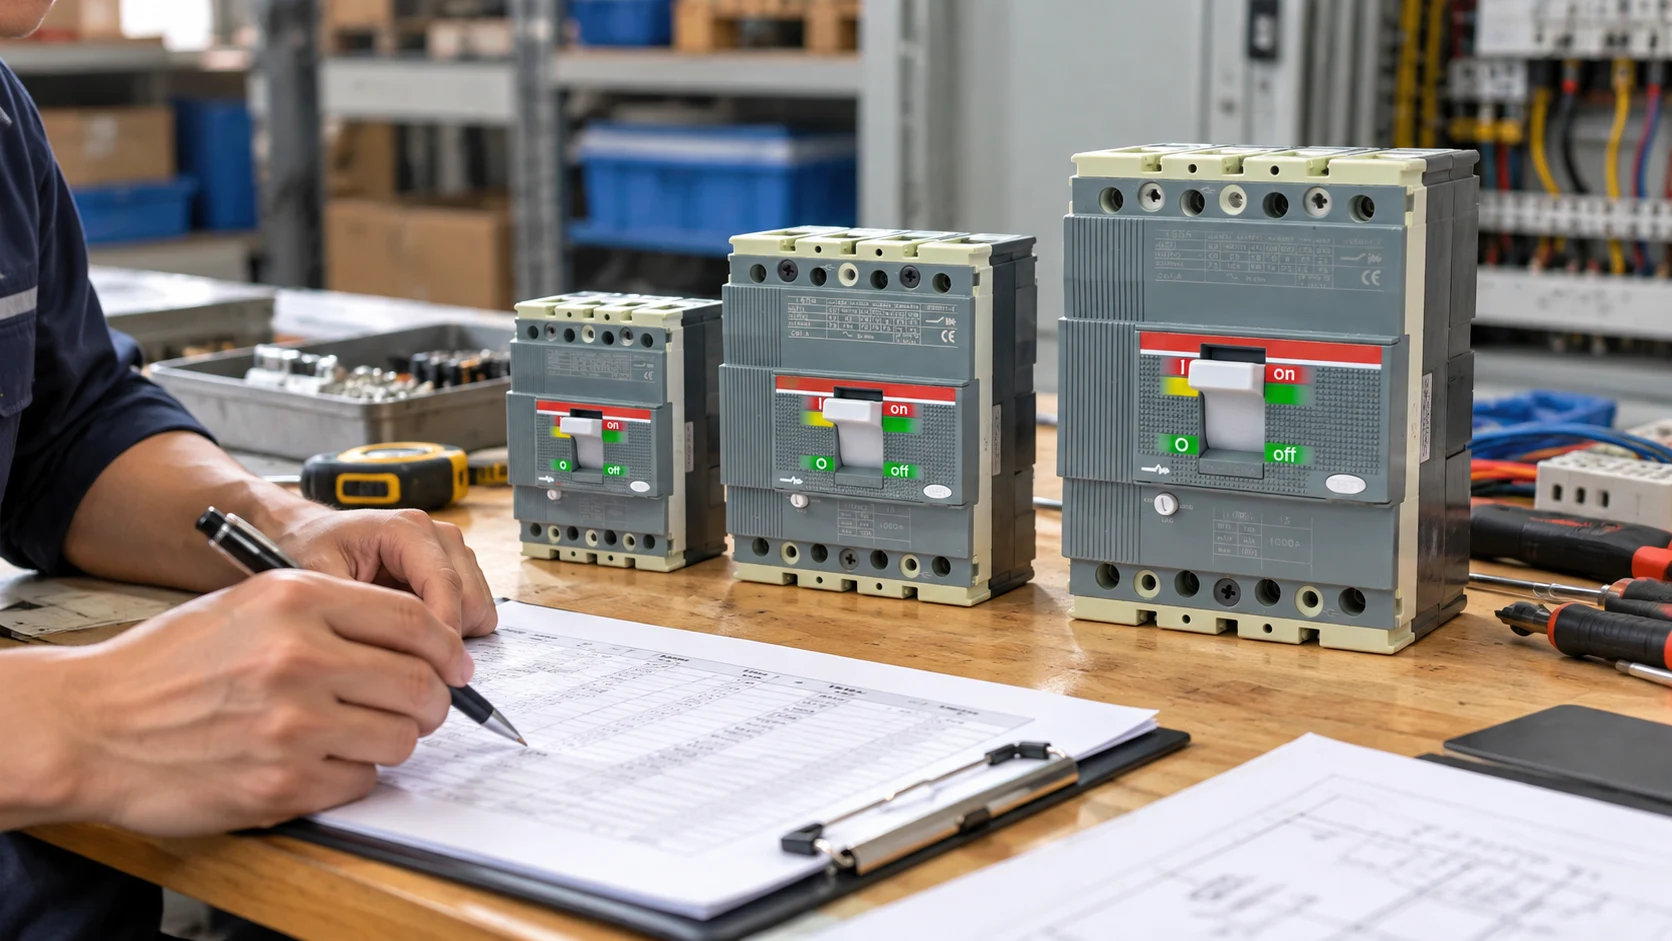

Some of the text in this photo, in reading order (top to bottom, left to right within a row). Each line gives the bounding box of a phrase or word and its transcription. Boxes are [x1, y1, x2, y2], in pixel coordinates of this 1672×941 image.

[1361, 270, 1381, 286] CE
[941, 330, 955, 344] CE
[1273, 367, 1296, 381] on
[890, 404, 908, 415] on
[606, 421, 619, 430] on
[1273, 446, 1297, 462] off
[607, 466, 621, 476] off
[890, 464, 909, 478] off
